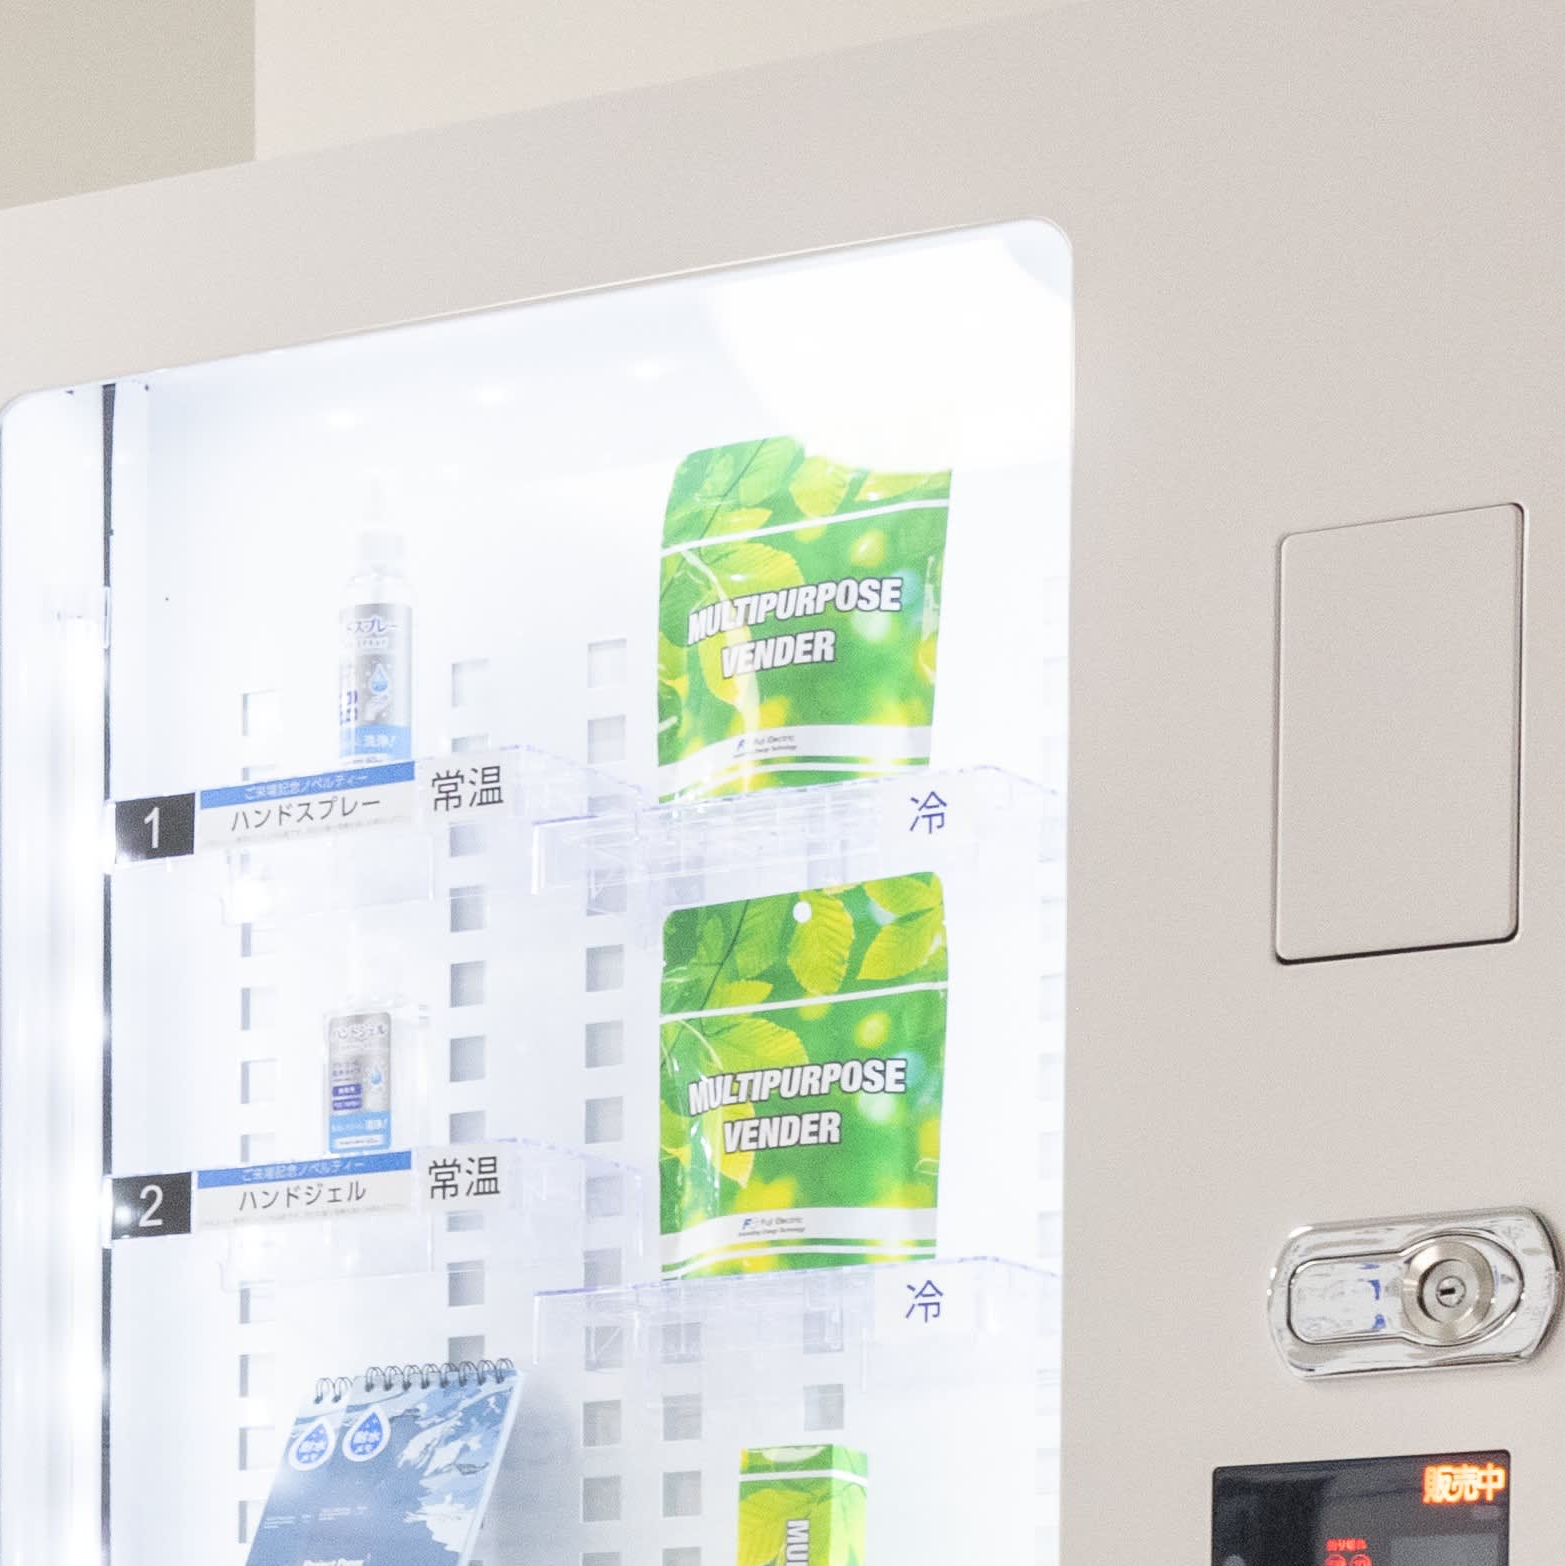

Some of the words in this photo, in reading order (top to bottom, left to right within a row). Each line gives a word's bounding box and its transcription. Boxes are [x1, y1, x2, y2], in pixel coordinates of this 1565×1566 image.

[687, 577, 903, 646] MULTIPURPOSE
[721, 629, 836, 679] VENDER
[430, 766, 505, 813] 常温
[143, 806, 161, 849] 1
[230, 796, 382, 832] ハンドスプレー
[909, 791, 948, 834] 冷
[688, 1058, 907, 1117] MULTIPURPOSE
[722, 1110, 843, 1155] VENDER
[238, 1180, 367, 1212] ハンドジェル
[428, 1155, 501, 1200] 常温
[138, 1184, 163, 1228] 2
[904, 1280, 944, 1323] 冷
